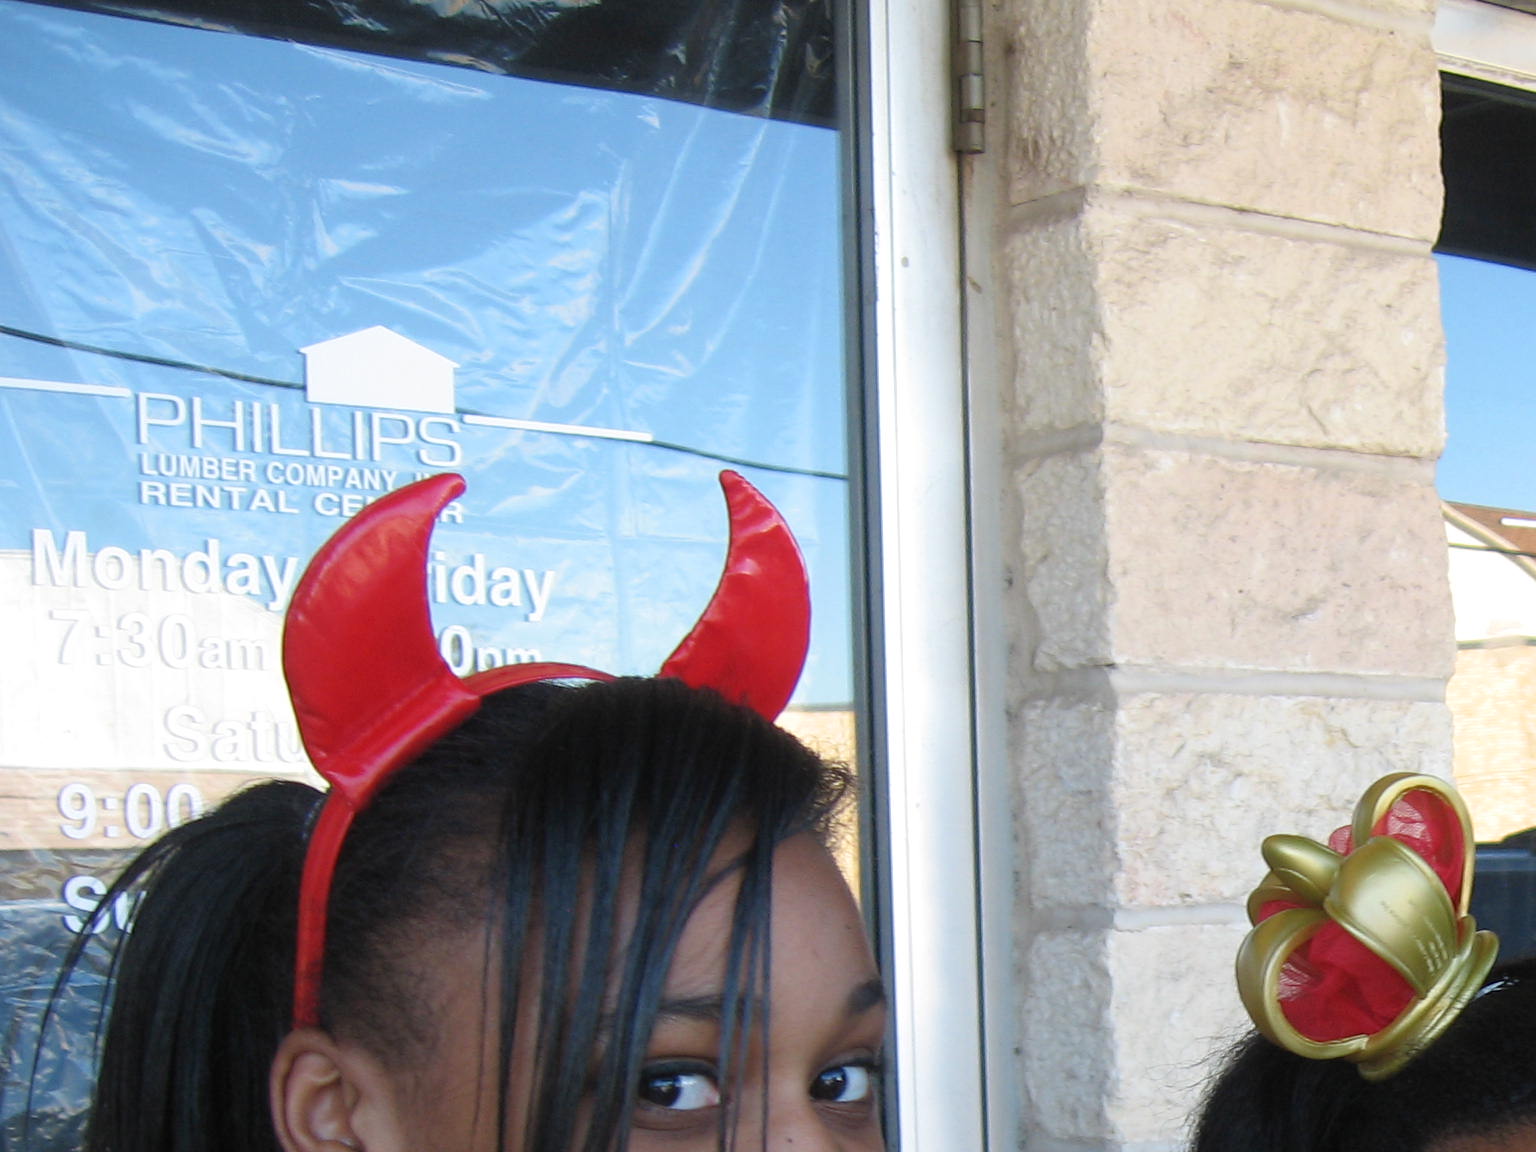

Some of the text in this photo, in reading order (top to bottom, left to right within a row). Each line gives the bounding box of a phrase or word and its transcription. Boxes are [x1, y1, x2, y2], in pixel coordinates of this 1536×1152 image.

[137, 391, 463, 468] PHILLIPS
[140, 480, 300, 514] RENTAL
[141, 452, 257, 482] LUMBER
[32, 528, 556, 622] Monday iday
[48, 607, 272, 671] 7:30am
